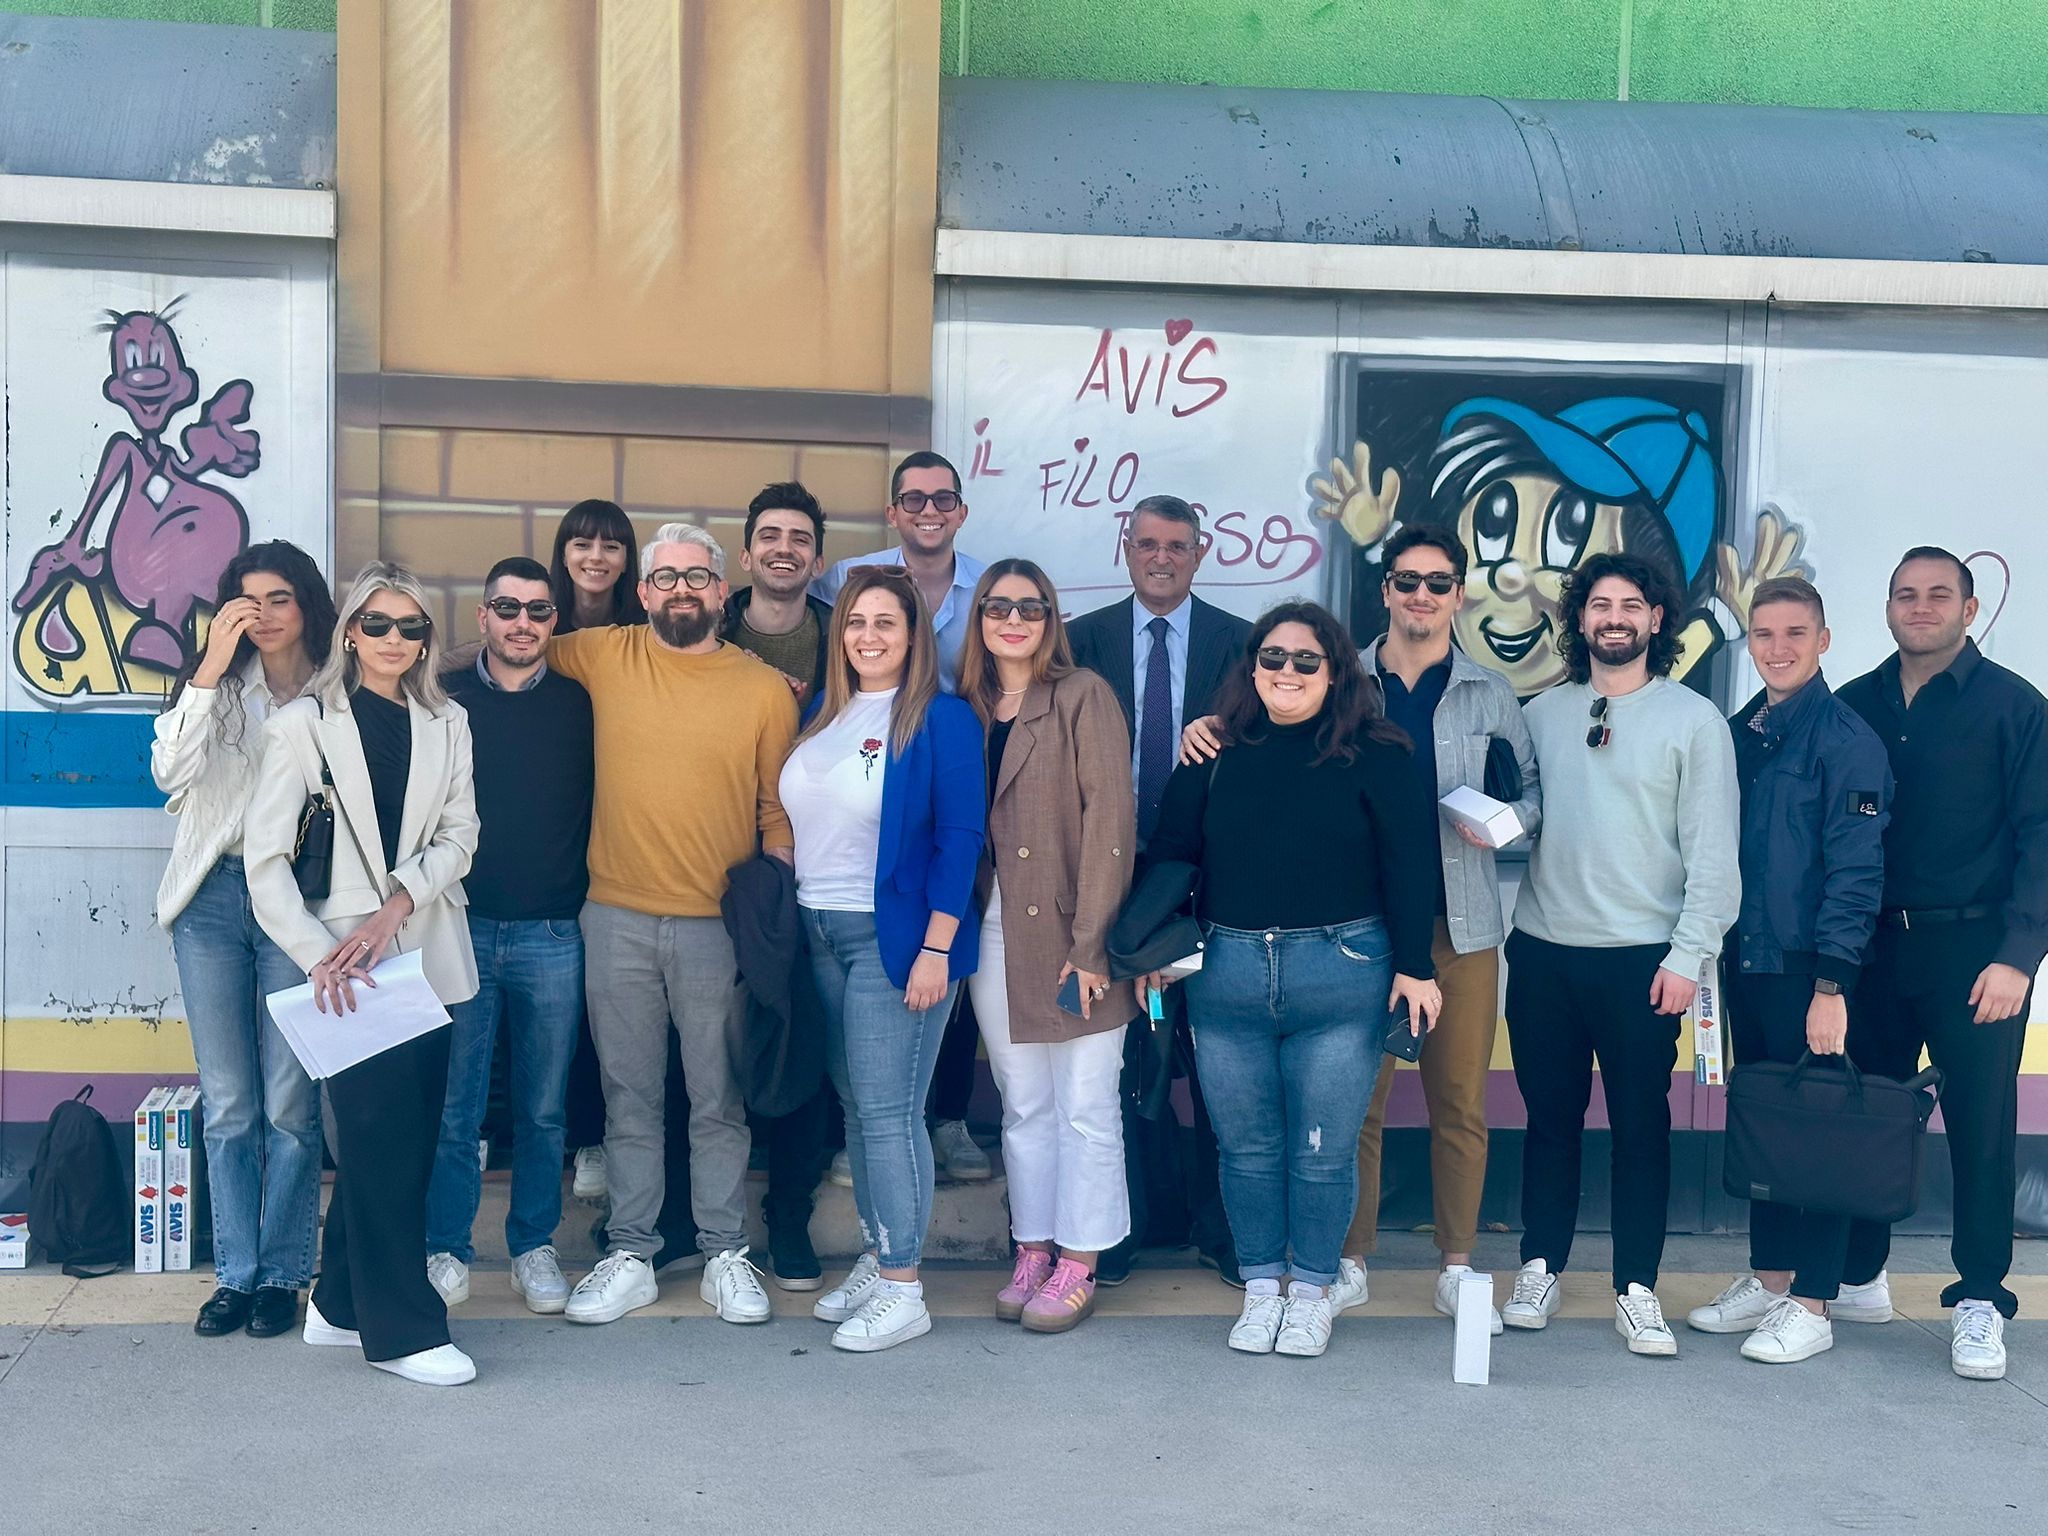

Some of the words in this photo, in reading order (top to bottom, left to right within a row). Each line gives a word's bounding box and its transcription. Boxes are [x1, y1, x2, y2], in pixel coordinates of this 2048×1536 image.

[1701, 986, 1713, 1018] AVIS
[140, 1203, 154, 1244] AVIS
[169, 1202, 183, 1242] AVIS
